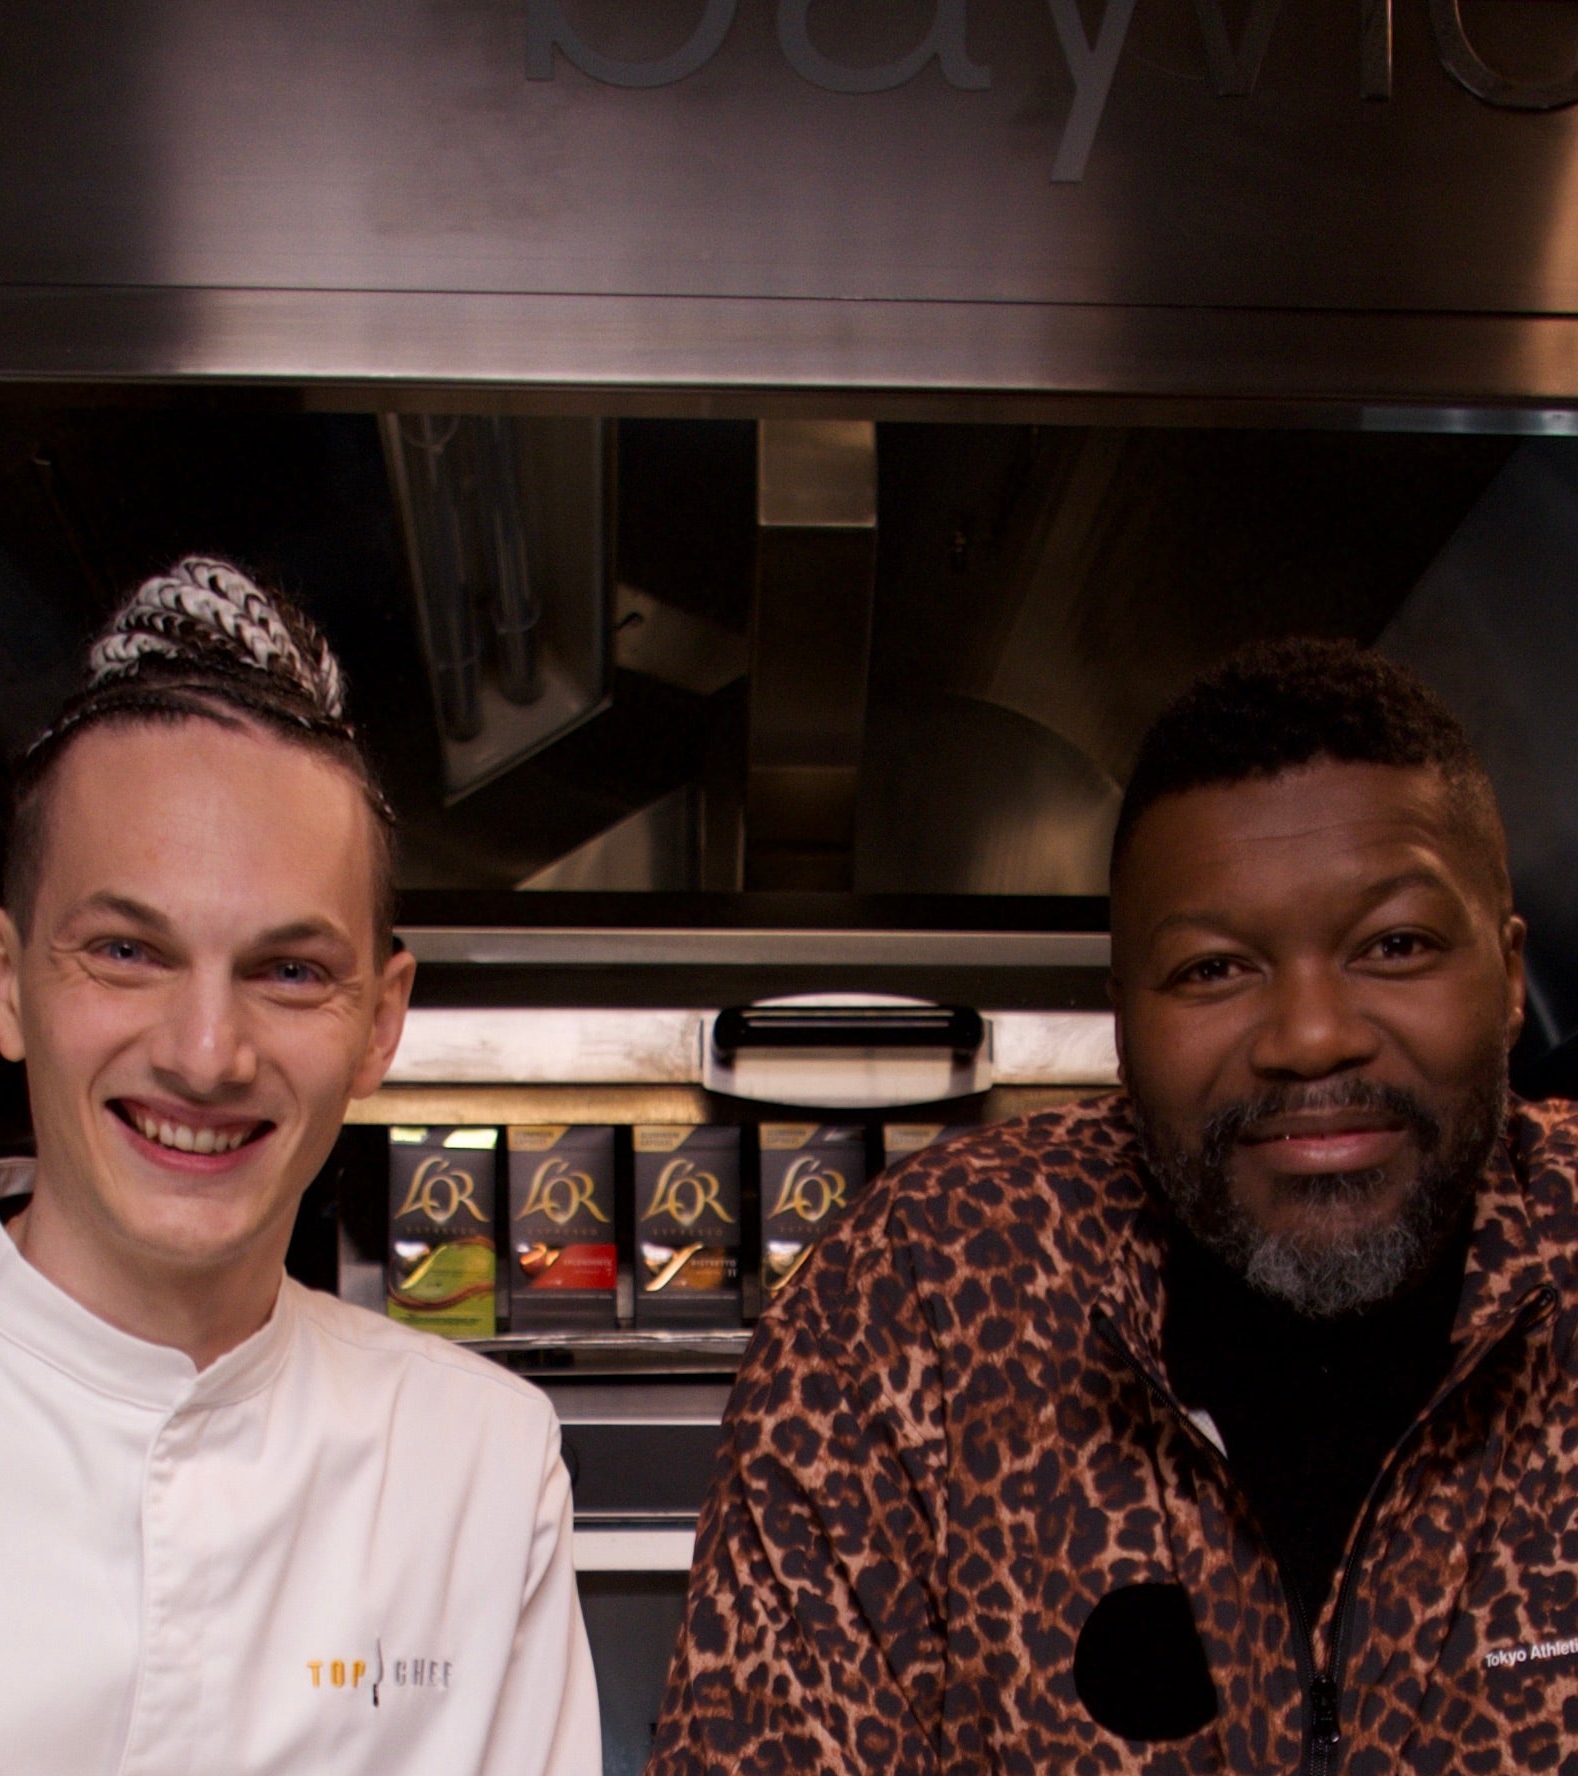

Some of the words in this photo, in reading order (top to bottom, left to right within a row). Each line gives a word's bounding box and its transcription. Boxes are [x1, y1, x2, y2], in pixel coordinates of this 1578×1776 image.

[394, 1155, 491, 1224] L'OR
[513, 1157, 611, 1225] L'OR
[640, 1157, 737, 1226] L'OR
[767, 1155, 847, 1223] L'OR
[308, 1659, 367, 1689] TOP
[394, 1659, 453, 1688] CHEF
[1484, 1649, 1527, 1668] Tokyo
